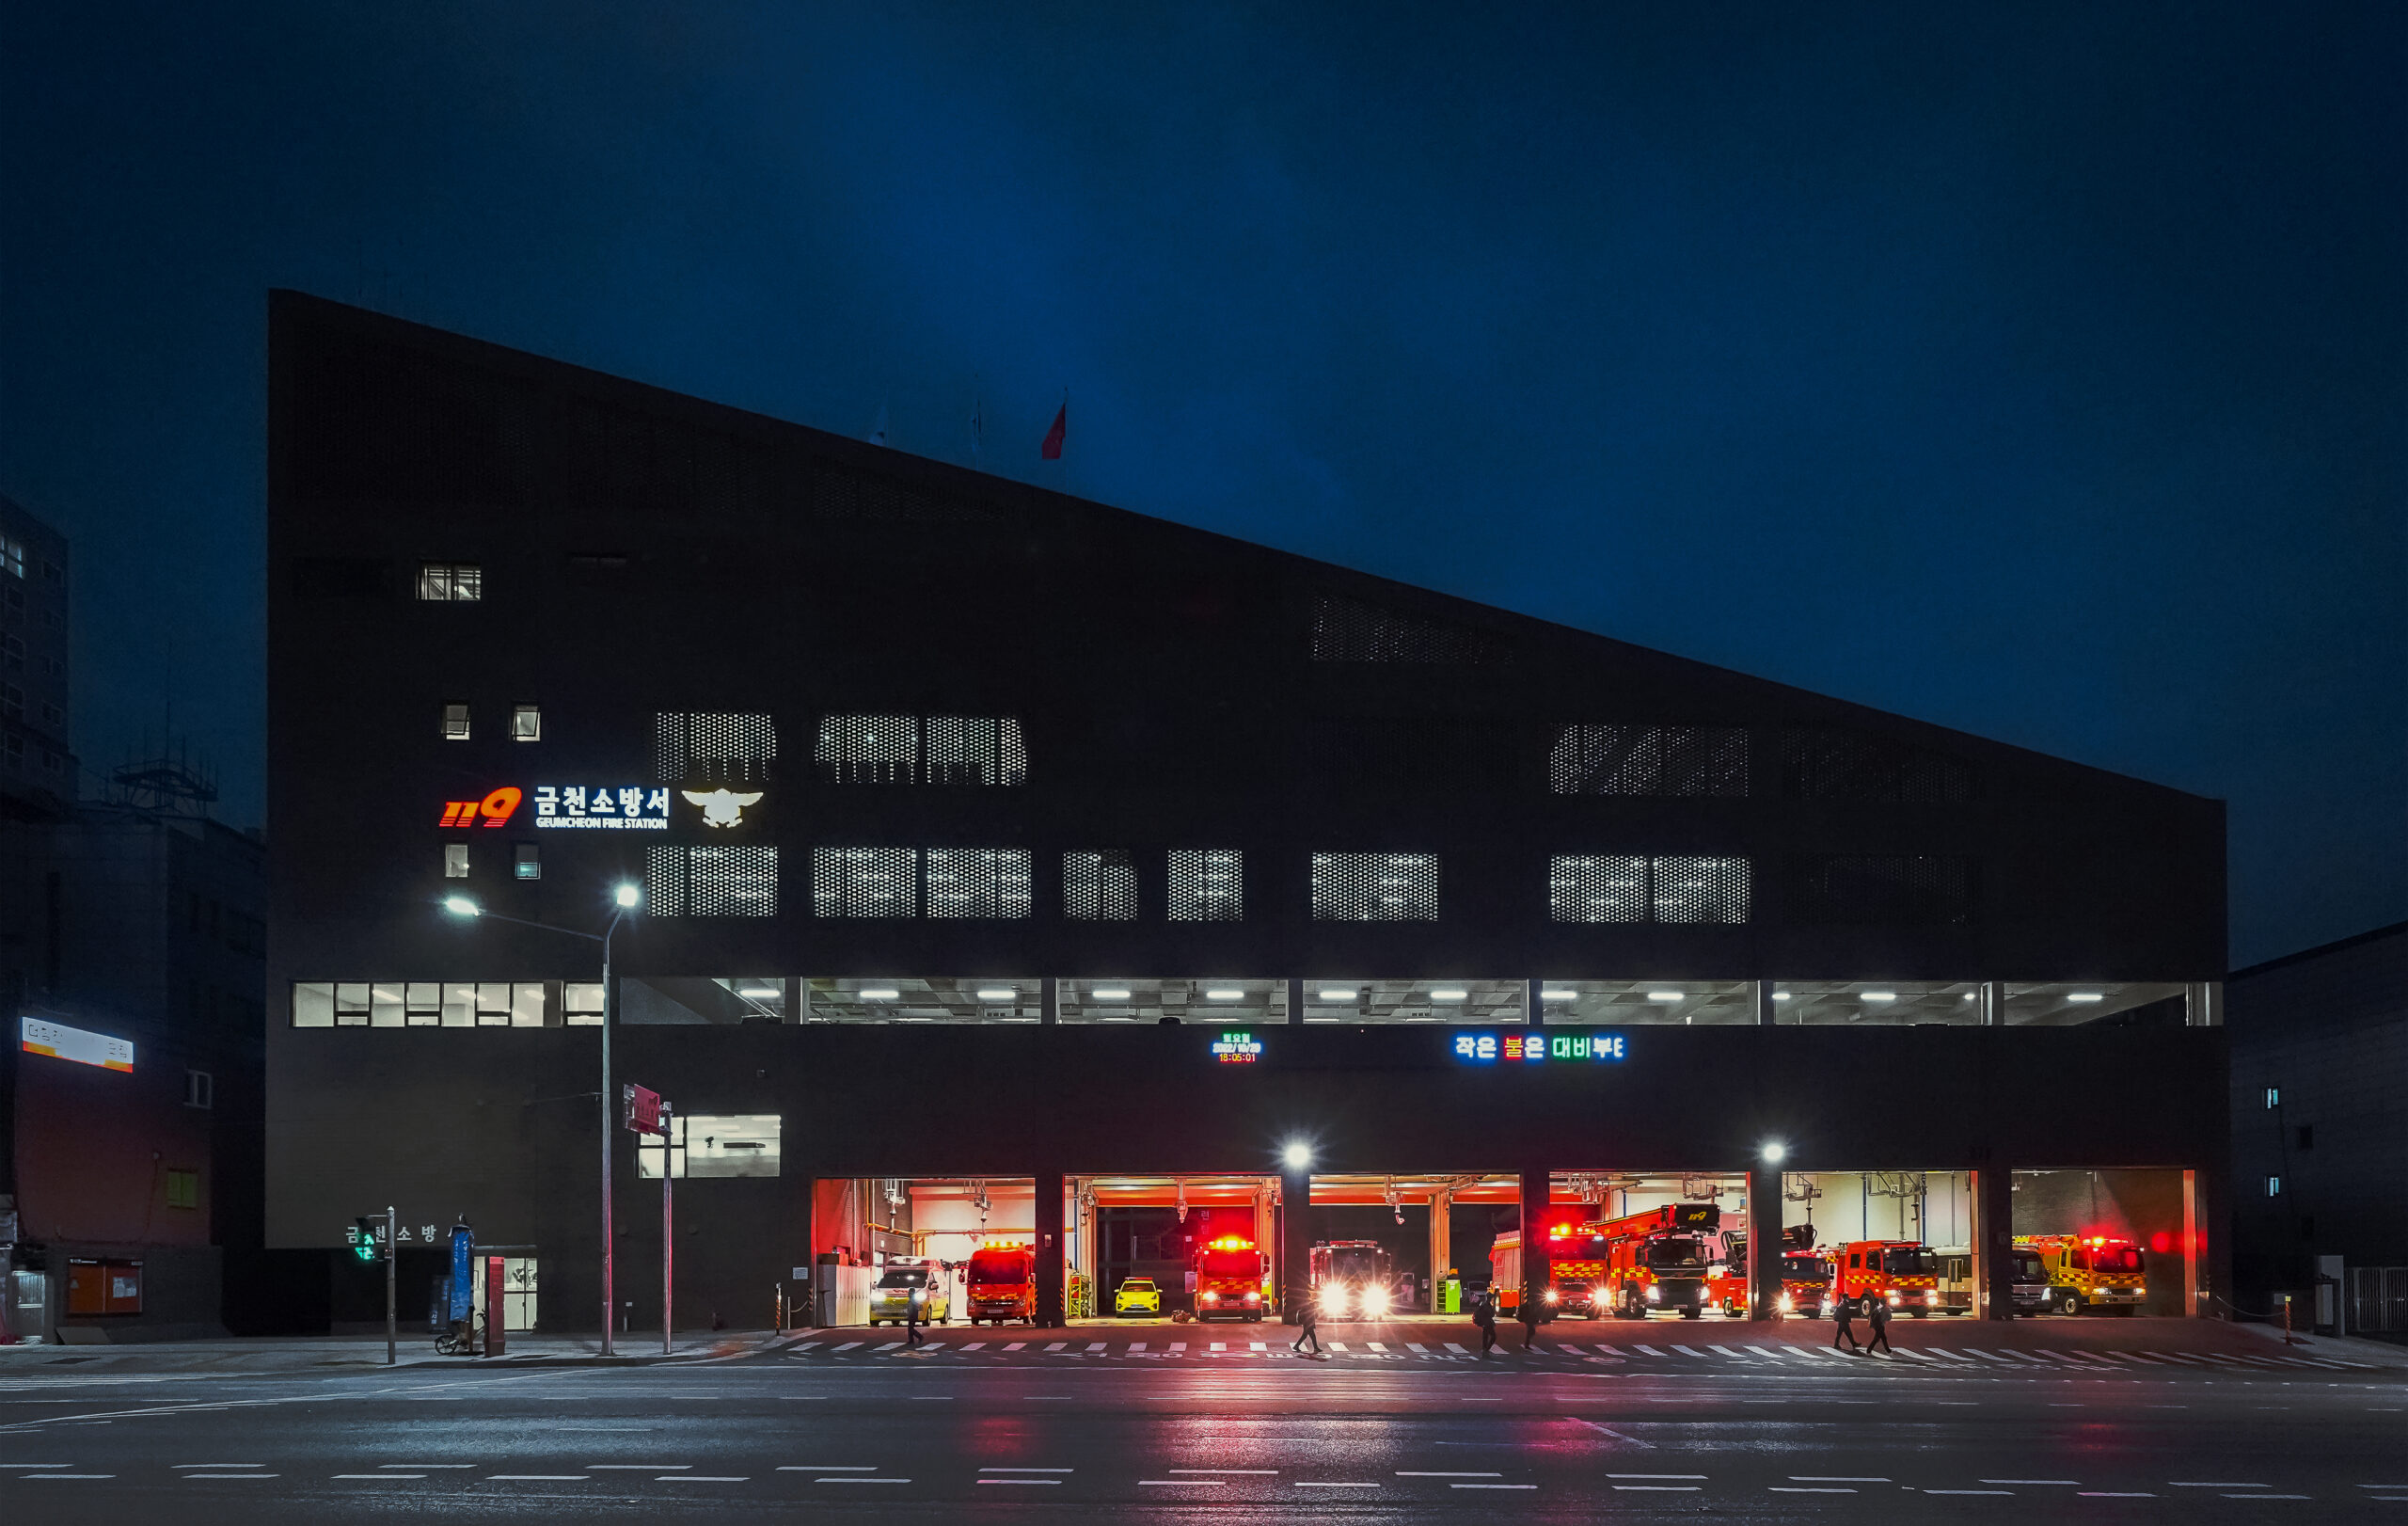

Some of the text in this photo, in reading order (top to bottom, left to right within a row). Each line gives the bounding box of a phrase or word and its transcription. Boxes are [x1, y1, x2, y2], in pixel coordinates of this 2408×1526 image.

[439, 787, 522, 828] 119
[534, 786, 670, 817] 금천소방서
[536, 817, 668, 830] GEUMCHEON FIRE STATION
[1219, 1053, 1256, 1062] 18:05:01
[1456, 1037, 1497, 1058] 작은
[1505, 1037, 1545, 1058] 불은
[1688, 1211, 1707, 1220] 119
[345, 1224, 452, 1244] 금천소방
